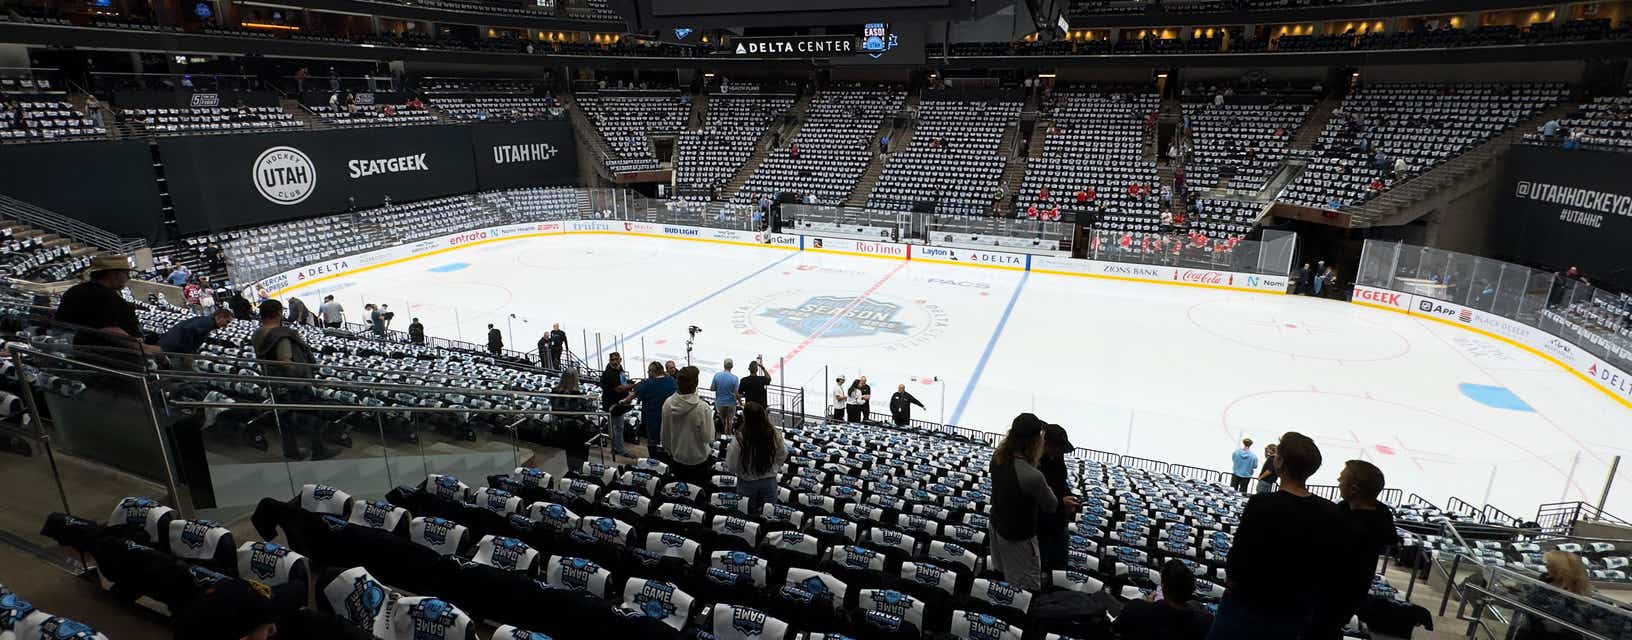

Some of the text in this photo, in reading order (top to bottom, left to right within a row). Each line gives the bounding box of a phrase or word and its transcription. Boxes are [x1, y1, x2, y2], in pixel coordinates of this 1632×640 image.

[749, 41, 850, 53] DELTA CENTER
[265, 153, 301, 166] HOCKEY
[493, 143, 558, 164] UTAH HC+
[348, 153, 429, 179] SEATGEEK
[263, 165, 308, 188] UTAH
[278, 189, 301, 198] CLUB
[1559, 208, 1603, 228] #UTAHHC
[450, 231, 487, 245] entrata
[679, 228, 699, 236] LIGHT
[855, 241, 901, 256] RioTinto
[922, 247, 947, 257] Layton
[982, 254, 1020, 265] DELTA
[308, 260, 349, 277] DELTA
[1103, 265, 1158, 277] ZIONS BANK
[1263, 279, 1285, 288] Nomi
[800, 303, 889, 321] SEASON
[366, 504, 388, 518] GAME
[673, 503, 692, 513] GAME
[727, 516, 746, 527] GAME
[184, 522, 209, 537] GAME
[425, 522, 448, 536] GAME
[883, 528, 903, 538] GAME
[252, 550, 278, 566] GAME
[495, 545, 518, 561] GAME
[848, 552, 870, 566] GAME
[563, 566, 589, 582] GAME
[726, 564, 751, 574] GAME
[917, 566, 942, 578] GAME
[1129, 565, 1149, 575] GAME
[643, 585, 672, 602] GAME
[990, 582, 1015, 597] GAME
[879, 601, 905, 617] GAME
[735, 608, 766, 625] GAME
[415, 618, 445, 637] GAME
[971, 621, 1000, 638] GAME
